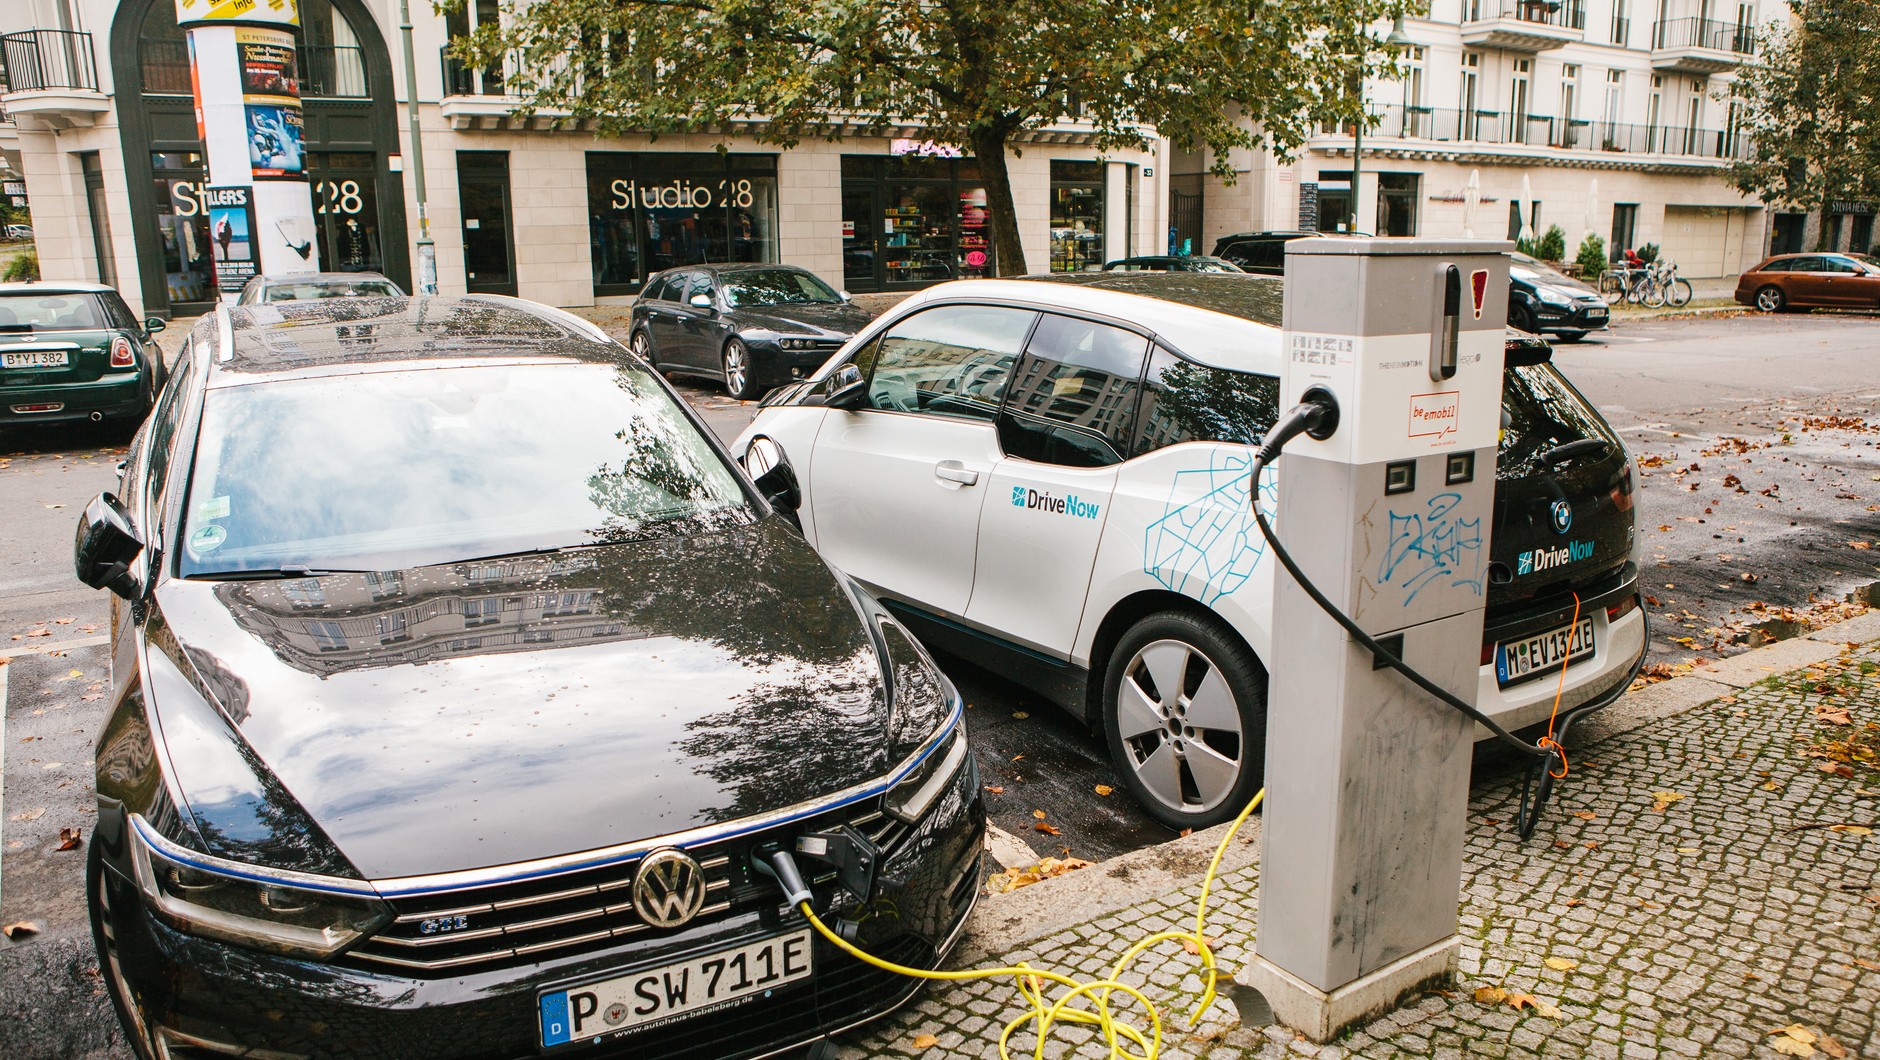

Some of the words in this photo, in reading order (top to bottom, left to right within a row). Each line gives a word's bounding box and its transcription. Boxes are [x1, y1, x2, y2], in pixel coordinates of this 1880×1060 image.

[316, 180, 363, 214] 28
[611, 179, 712, 210] Studio
[719, 179, 753, 208] 28
[7, 354, 15, 364] B
[23, 353, 38, 364] YI
[41, 353, 63, 363] 382
[1413, 405, 1424, 418] be
[1424, 405, 1455, 420] emobil
[1028, 488, 1100, 520] DriveNow
[1533, 540, 1594, 572] DriveNow
[1507, 646, 1519, 676] M
[1529, 637, 1548, 668] EV
[420, 915, 468, 933] GTE
[570, 992, 598, 1032] P
[634, 967, 690, 1015] SW
[701, 936, 808, 998] 711E
[614, 995, 753, 1039] www.autohaus-babelsberg.de
